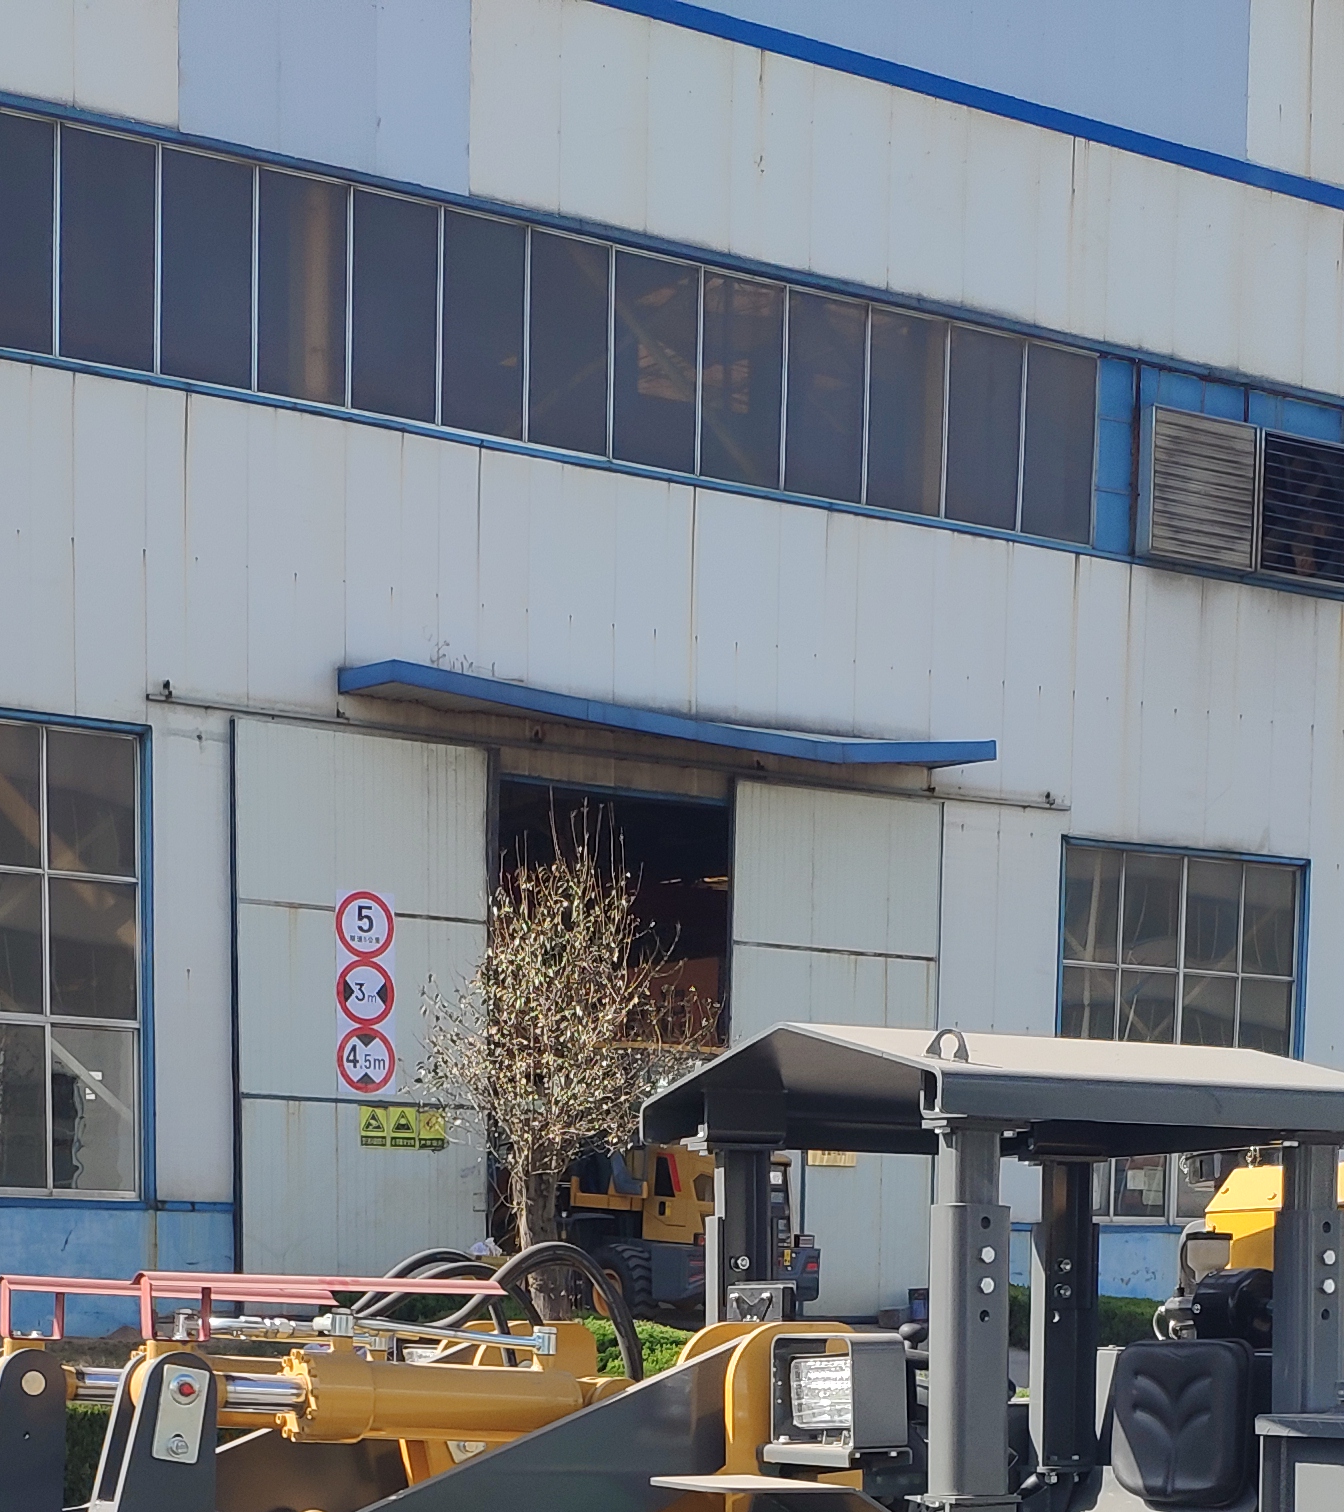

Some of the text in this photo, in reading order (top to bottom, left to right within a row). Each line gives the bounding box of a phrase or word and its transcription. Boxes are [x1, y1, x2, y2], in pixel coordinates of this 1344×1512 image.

[356, 905, 375, 934] 5
[354, 982, 377, 1004] 3m
[345, 1043, 386, 1071] 4.5m
